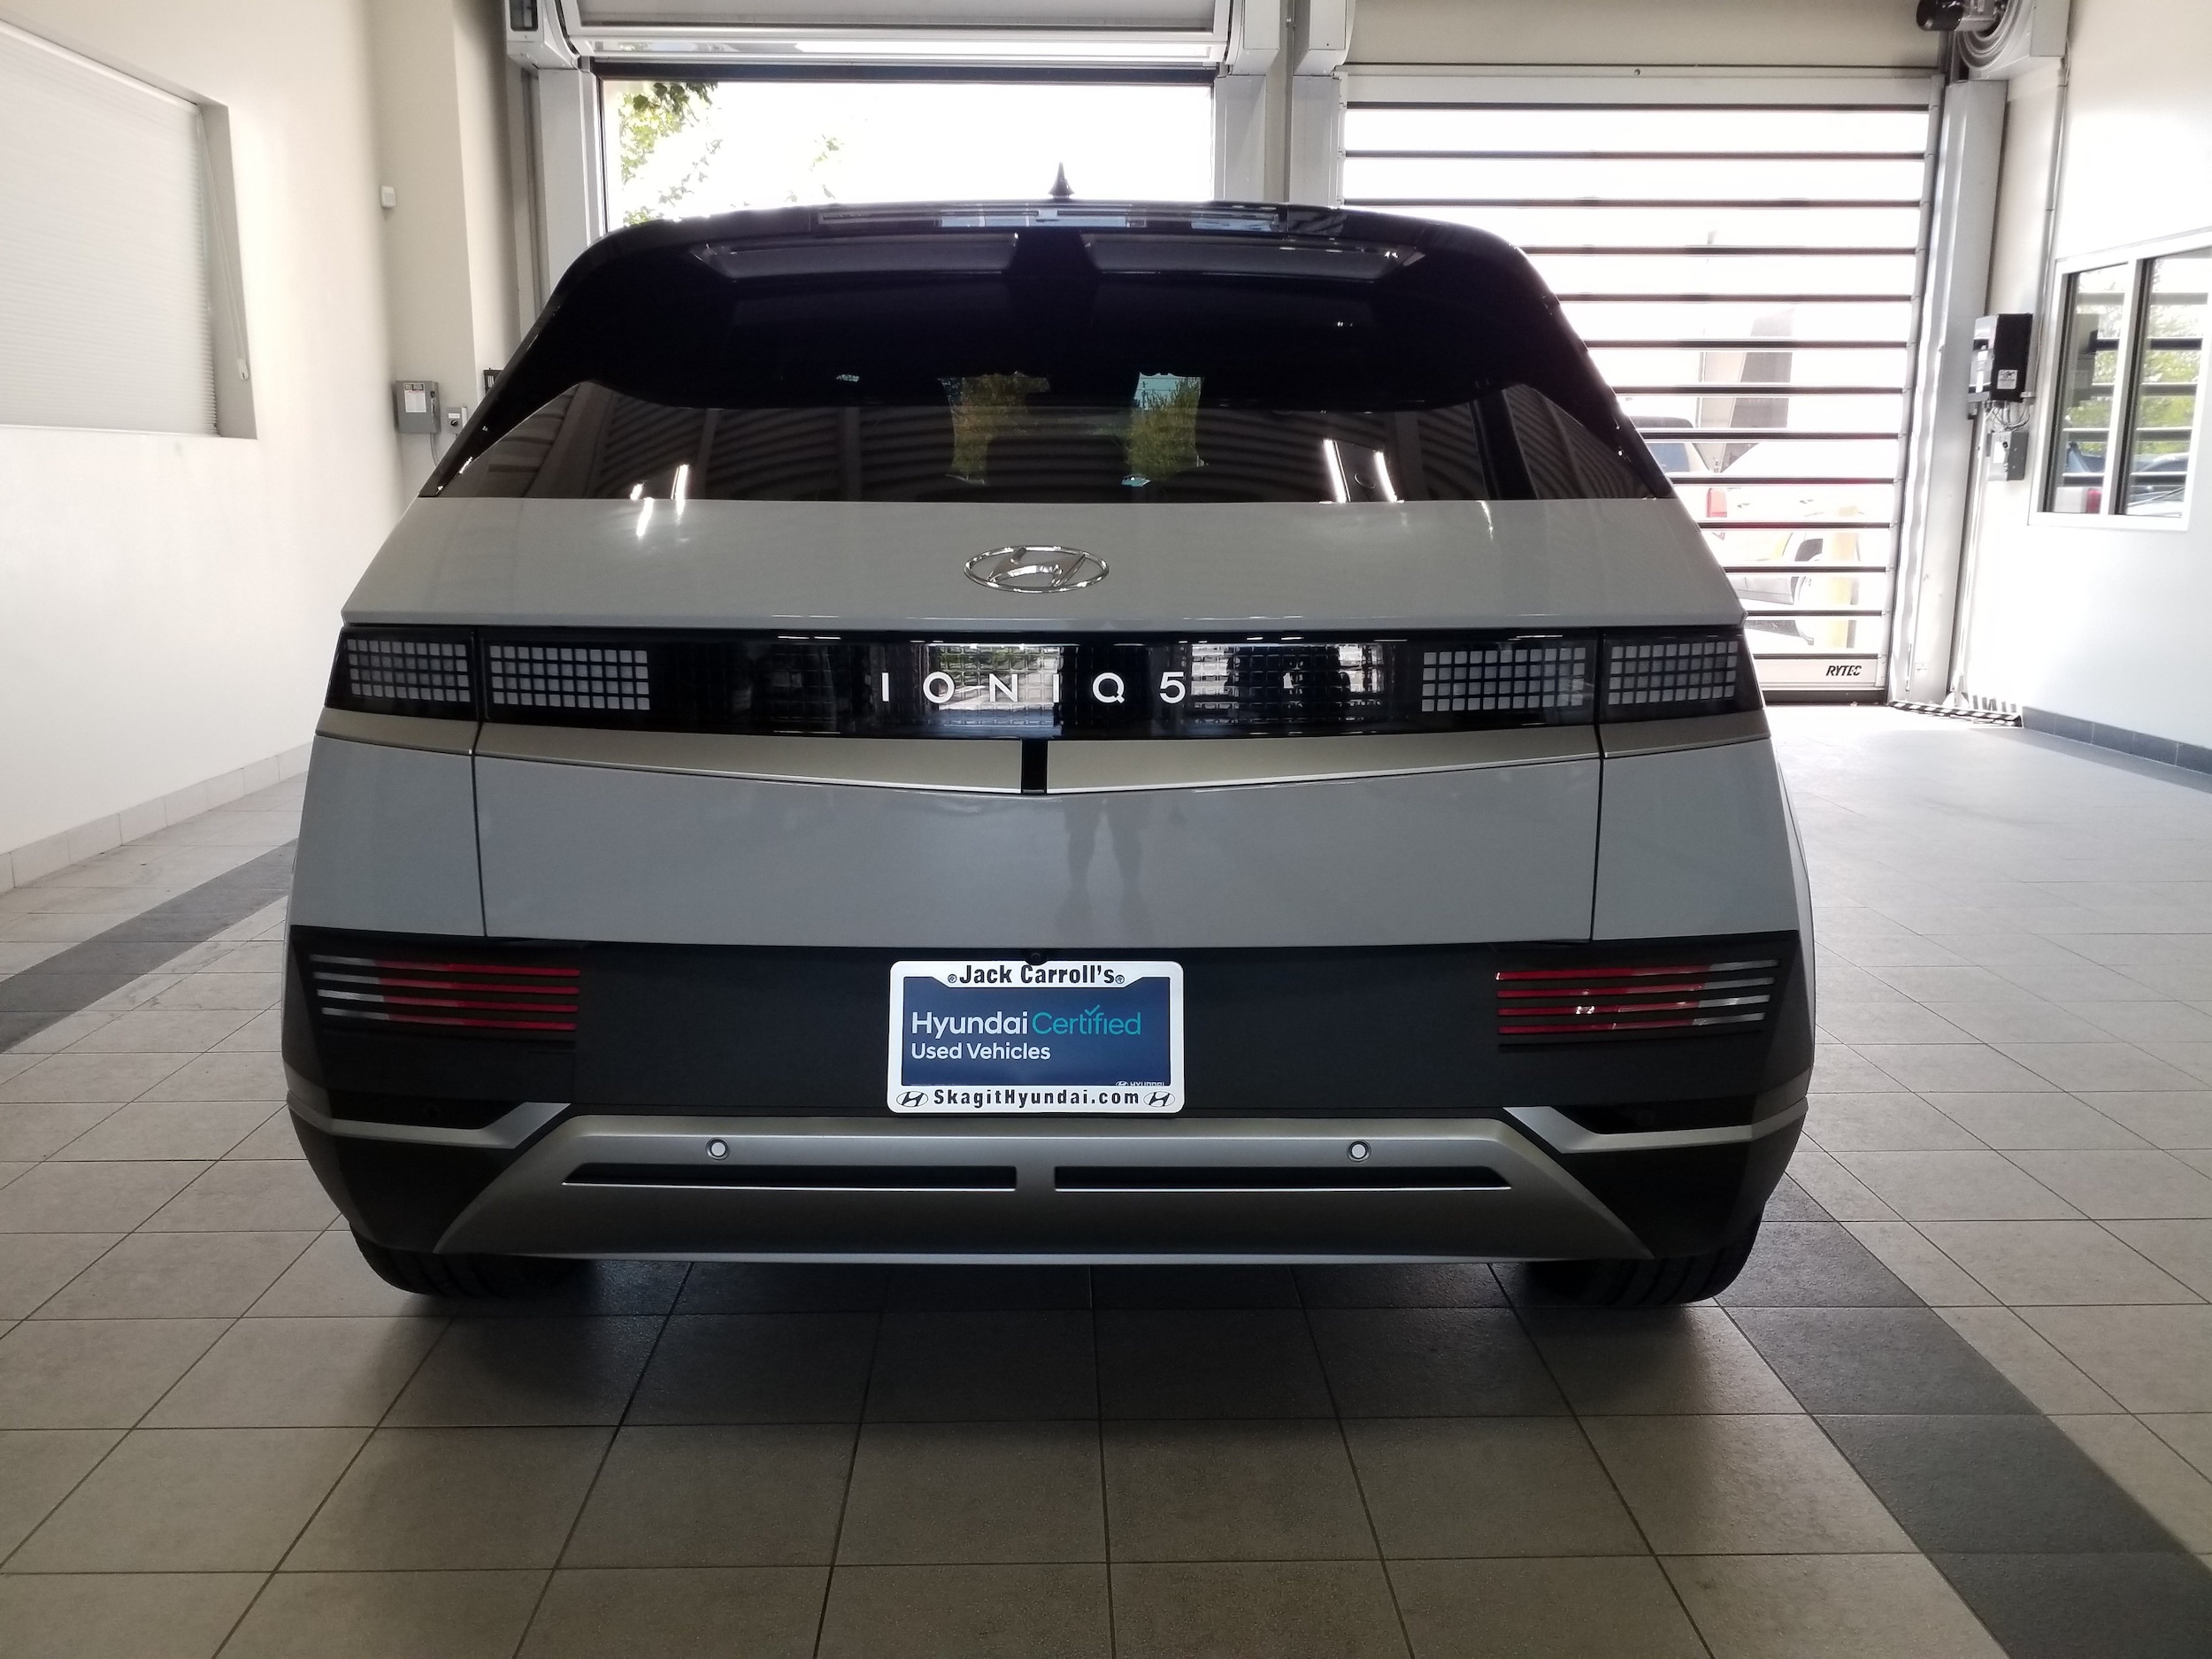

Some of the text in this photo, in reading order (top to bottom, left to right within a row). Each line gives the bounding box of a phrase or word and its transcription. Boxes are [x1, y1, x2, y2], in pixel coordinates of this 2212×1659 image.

[1825, 665, 1863, 676] RYTEC
[959, 964, 1115, 984] Jack Carroll's
[911, 1005, 1141, 1040] Hyundai Certified
[911, 1042, 1051, 1060] Used Vehicles
[933, 1088, 1140, 1109] SkagitHyundai.com
